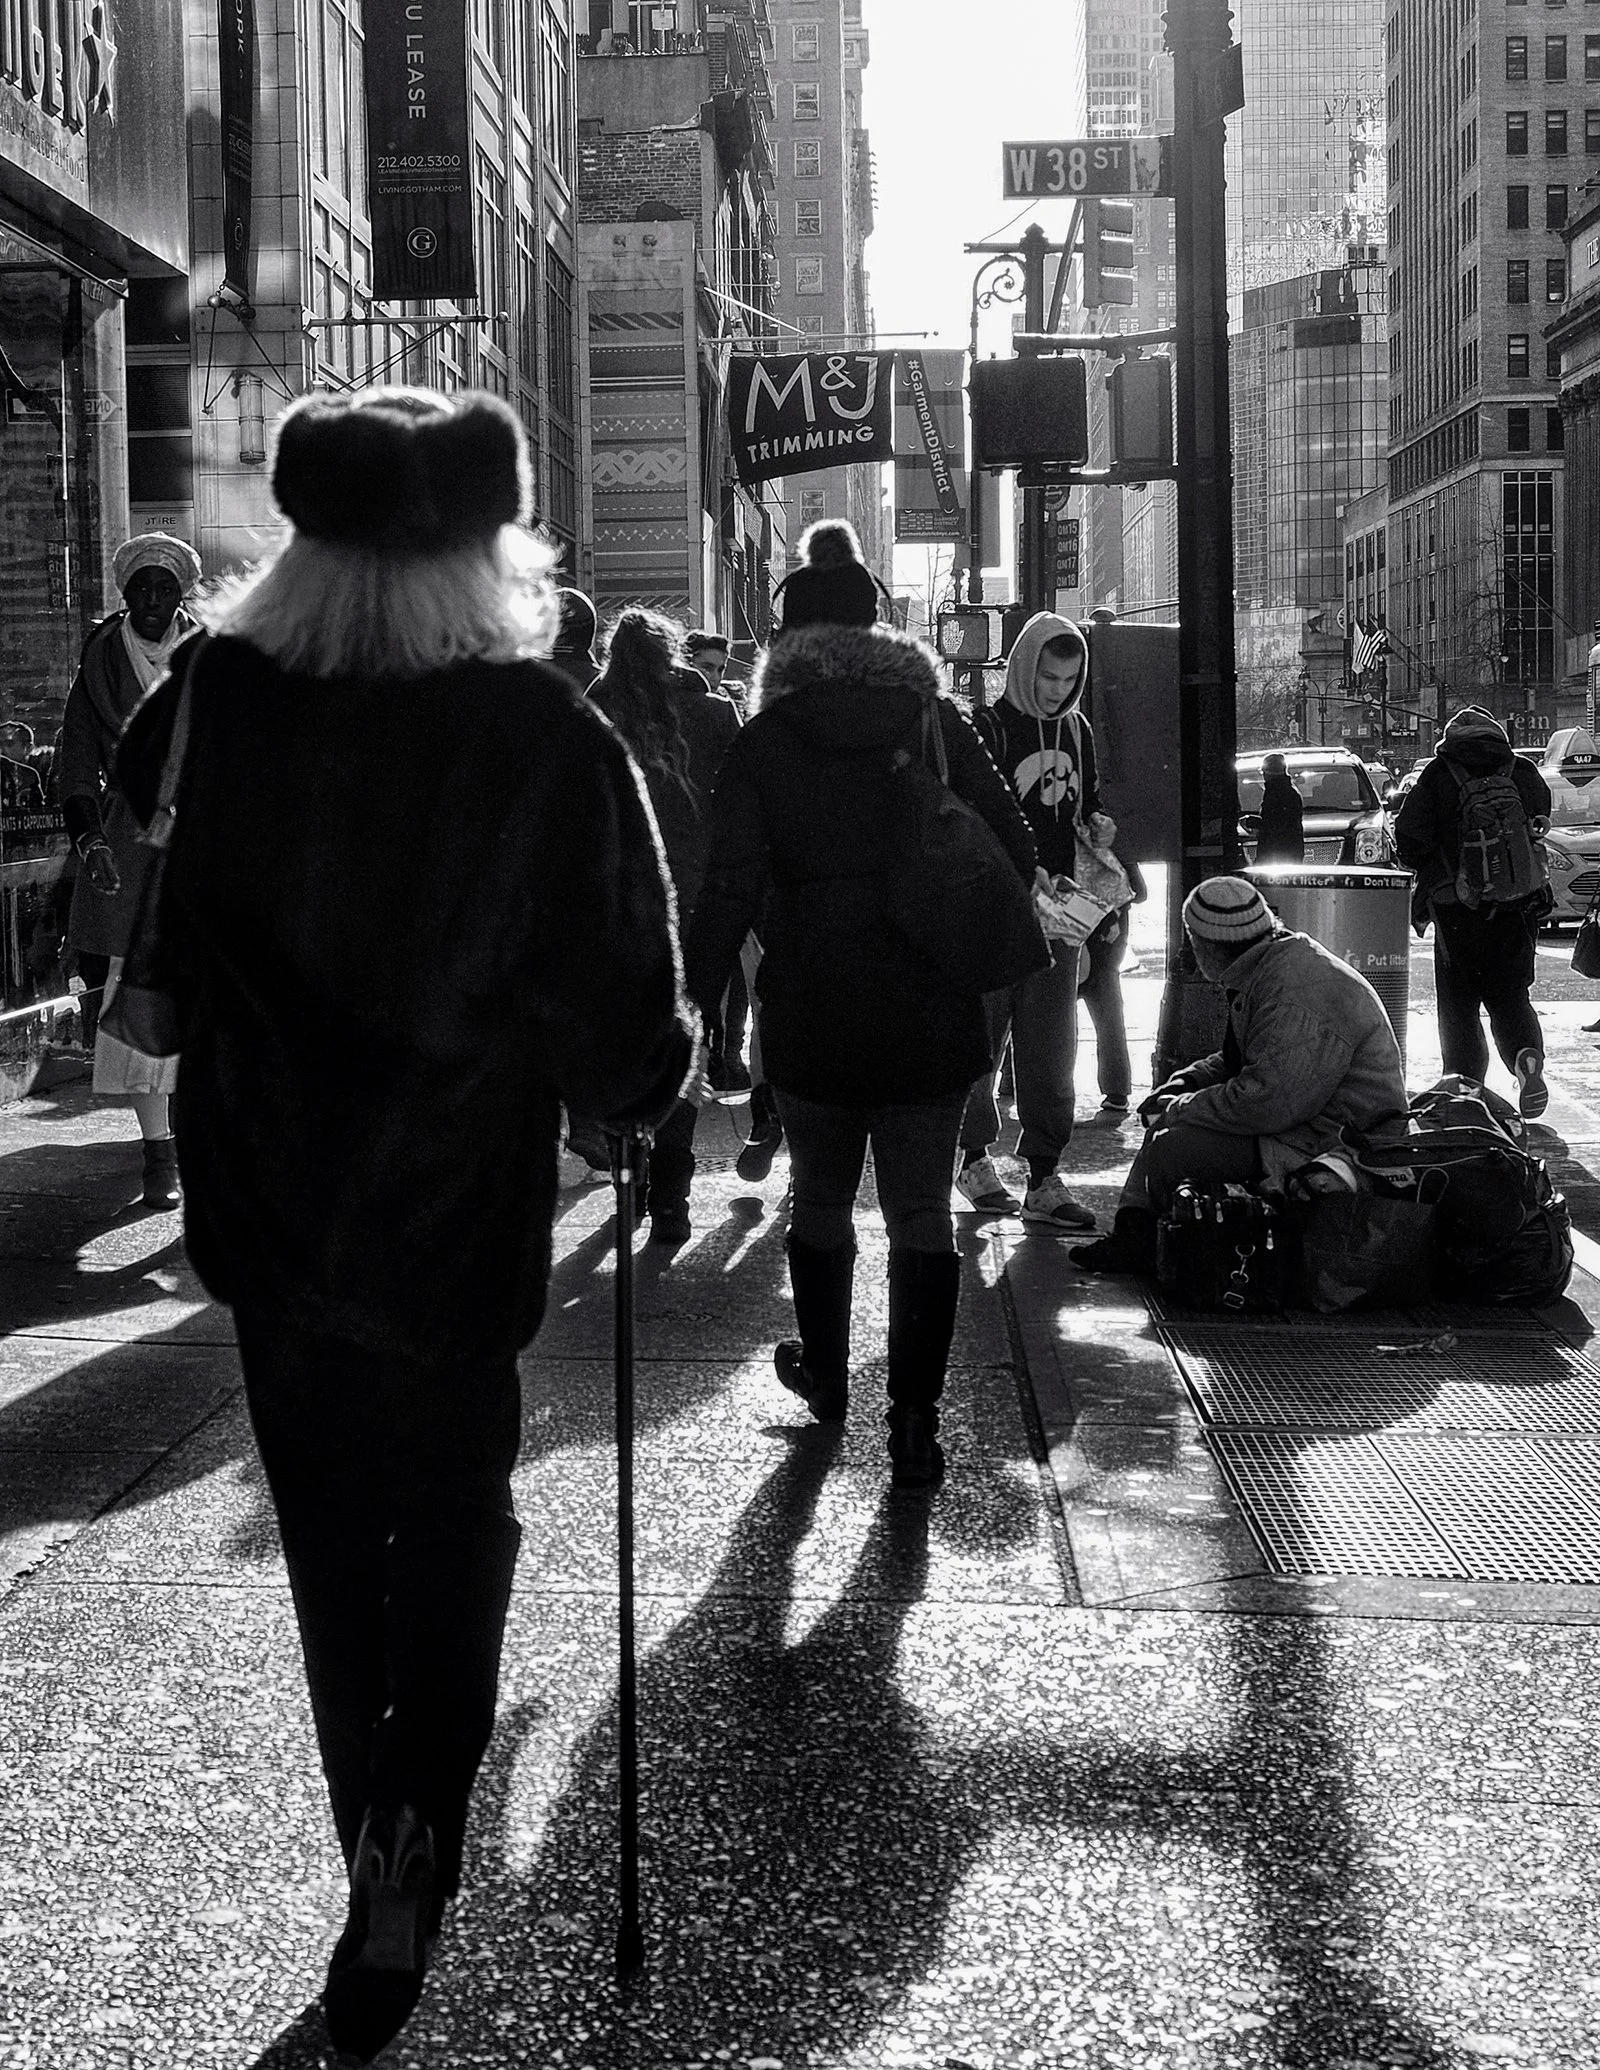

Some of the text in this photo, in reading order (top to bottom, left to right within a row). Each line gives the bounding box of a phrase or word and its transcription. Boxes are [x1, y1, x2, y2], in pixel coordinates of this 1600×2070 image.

[407, 34, 426, 119] LEASE
[377, 154, 461, 168] 212.402.5300
[1010, 147, 1122, 192] W 38 ST
[378, 184, 462, 194] LIVINGGOTHAM.COM
[745, 356, 878, 433] M&J
[747, 425, 874, 464] TRIMMING
[907, 359, 951, 493] #GarmentDistrict
[1363, 876, 1390, 887] Don't
[1367, 954, 1388, 967] Put
